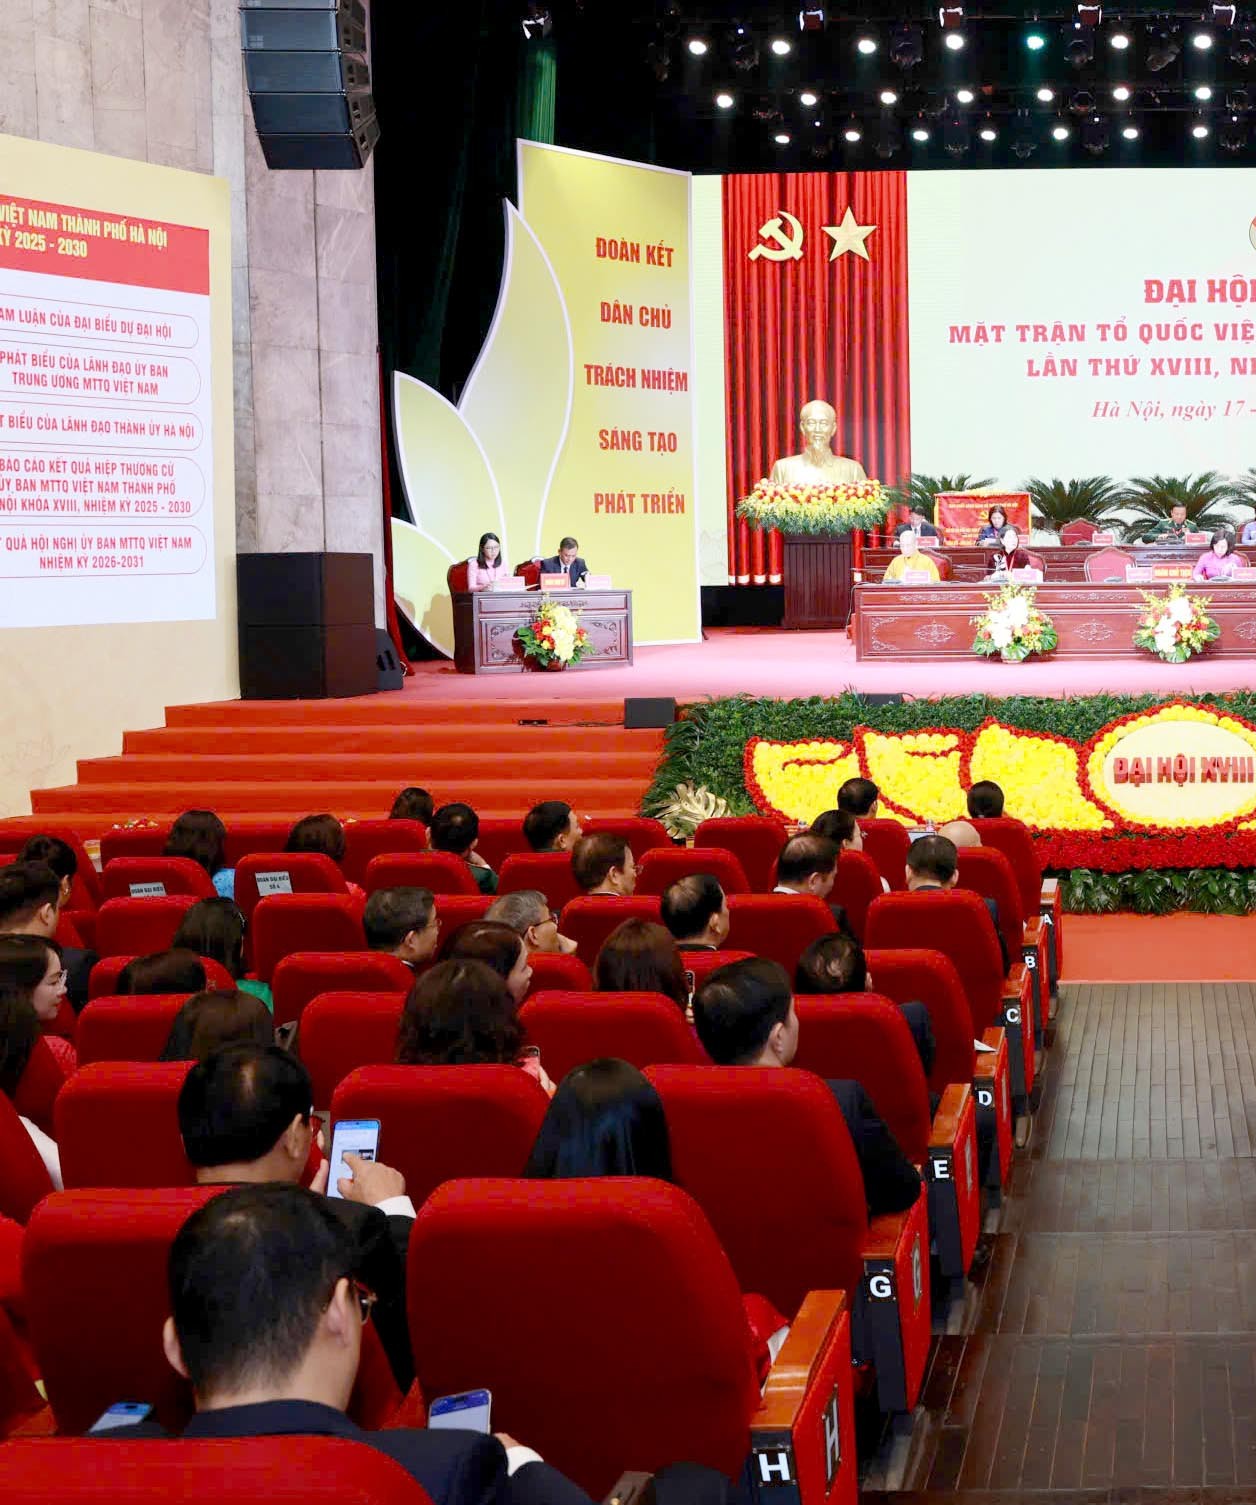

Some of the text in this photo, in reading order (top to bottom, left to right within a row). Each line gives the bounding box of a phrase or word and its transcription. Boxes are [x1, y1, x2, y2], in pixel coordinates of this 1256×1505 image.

[28, 208, 57, 230] NAM
[61, 214, 100, 237] THÀNH
[104, 218, 127, 241] PHỐ
[130, 224, 145, 244] HÀ
[148, 226, 168, 250] NỘI
[15, 231, 46, 252] 2025
[57, 237, 88, 257] 2030
[595, 236, 674, 268] ĐOÀN KẾT
[1144, 279, 1197, 308] ĐẠI
[600, 299, 672, 329] DÂN CHỦ
[949, 321, 1005, 346] MẶT
[1016, 321, 1086, 346] TRẬN
[1096, 315, 1128, 342] TỔ
[1139, 317, 1203, 344] QUỐC
[583, 363, 688, 395] TRÁCH NHIỆM
[1027, 352, 1078, 377] LẦN
[1088, 354, 1141, 376] THỨ
[1150, 358, 1220, 379] XVIII,
[1092, 400, 1120, 418] Hà
[1171, 402, 1217, 421] ngày
[1223, 400, 1245, 416] 17
[598, 426, 678, 456] SÁNG TẠO
[593, 486, 685, 514] PHÁT TRIỂN
[1113, 753, 1254, 787] ĐẠI HỘI XVIII
[1043, 914, 1053, 925] A
[1025, 956, 1036, 968] B
[1006, 1008, 1019, 1022] C
[978, 1091, 993, 1106] D
[933, 1160, 949, 1179] E
[869, 1276, 892, 1298] G
[758, 1453, 790, 1482] H
